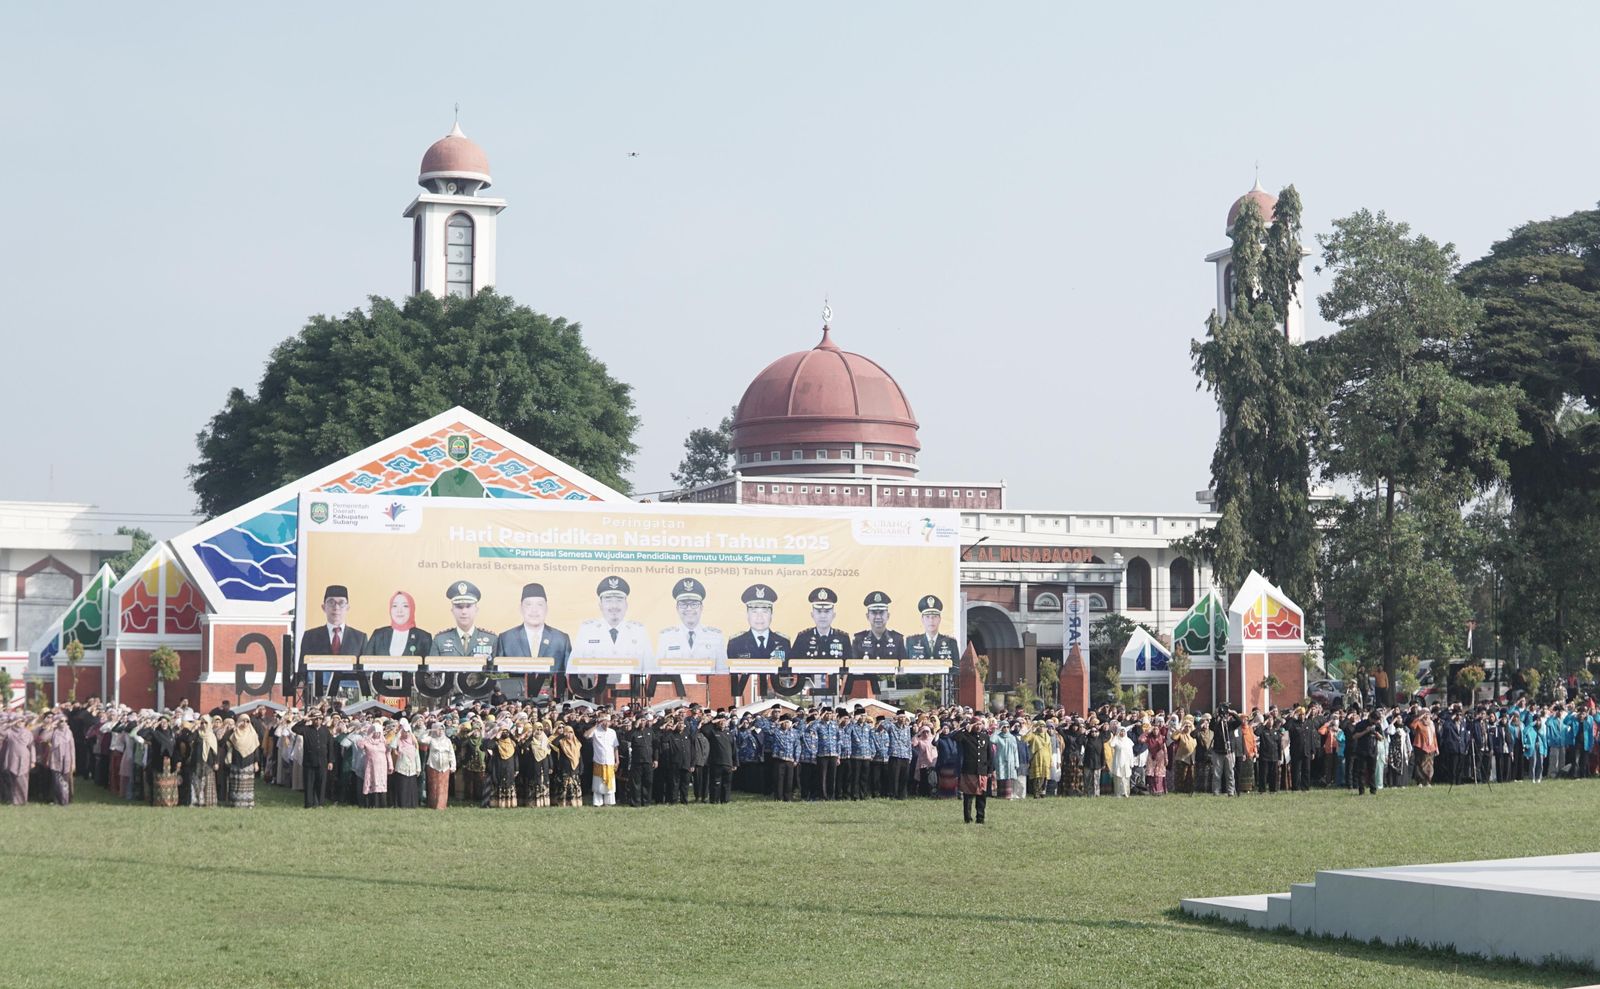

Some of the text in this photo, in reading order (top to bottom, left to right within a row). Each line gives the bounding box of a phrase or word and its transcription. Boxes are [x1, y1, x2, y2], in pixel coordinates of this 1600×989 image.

[333, 519, 359, 527] Subang
[602, 517, 685, 531] Peringatan
[450, 527, 830, 550] Hari Pendidikan Nasional Tahun 2025
[558, 551, 592, 559] Semesta
[594, 551, 635, 561] Wujudkan
[637, 552, 681, 560] Pendidikan
[719, 554, 743, 562] Untuk
[977, 547, 996, 561] AL
[418, 560, 860, 579] dan Deklarasi Bersama Sistem Penerimaan Murid Baru (SPMB) Tahun Ajaran 2025/2026
